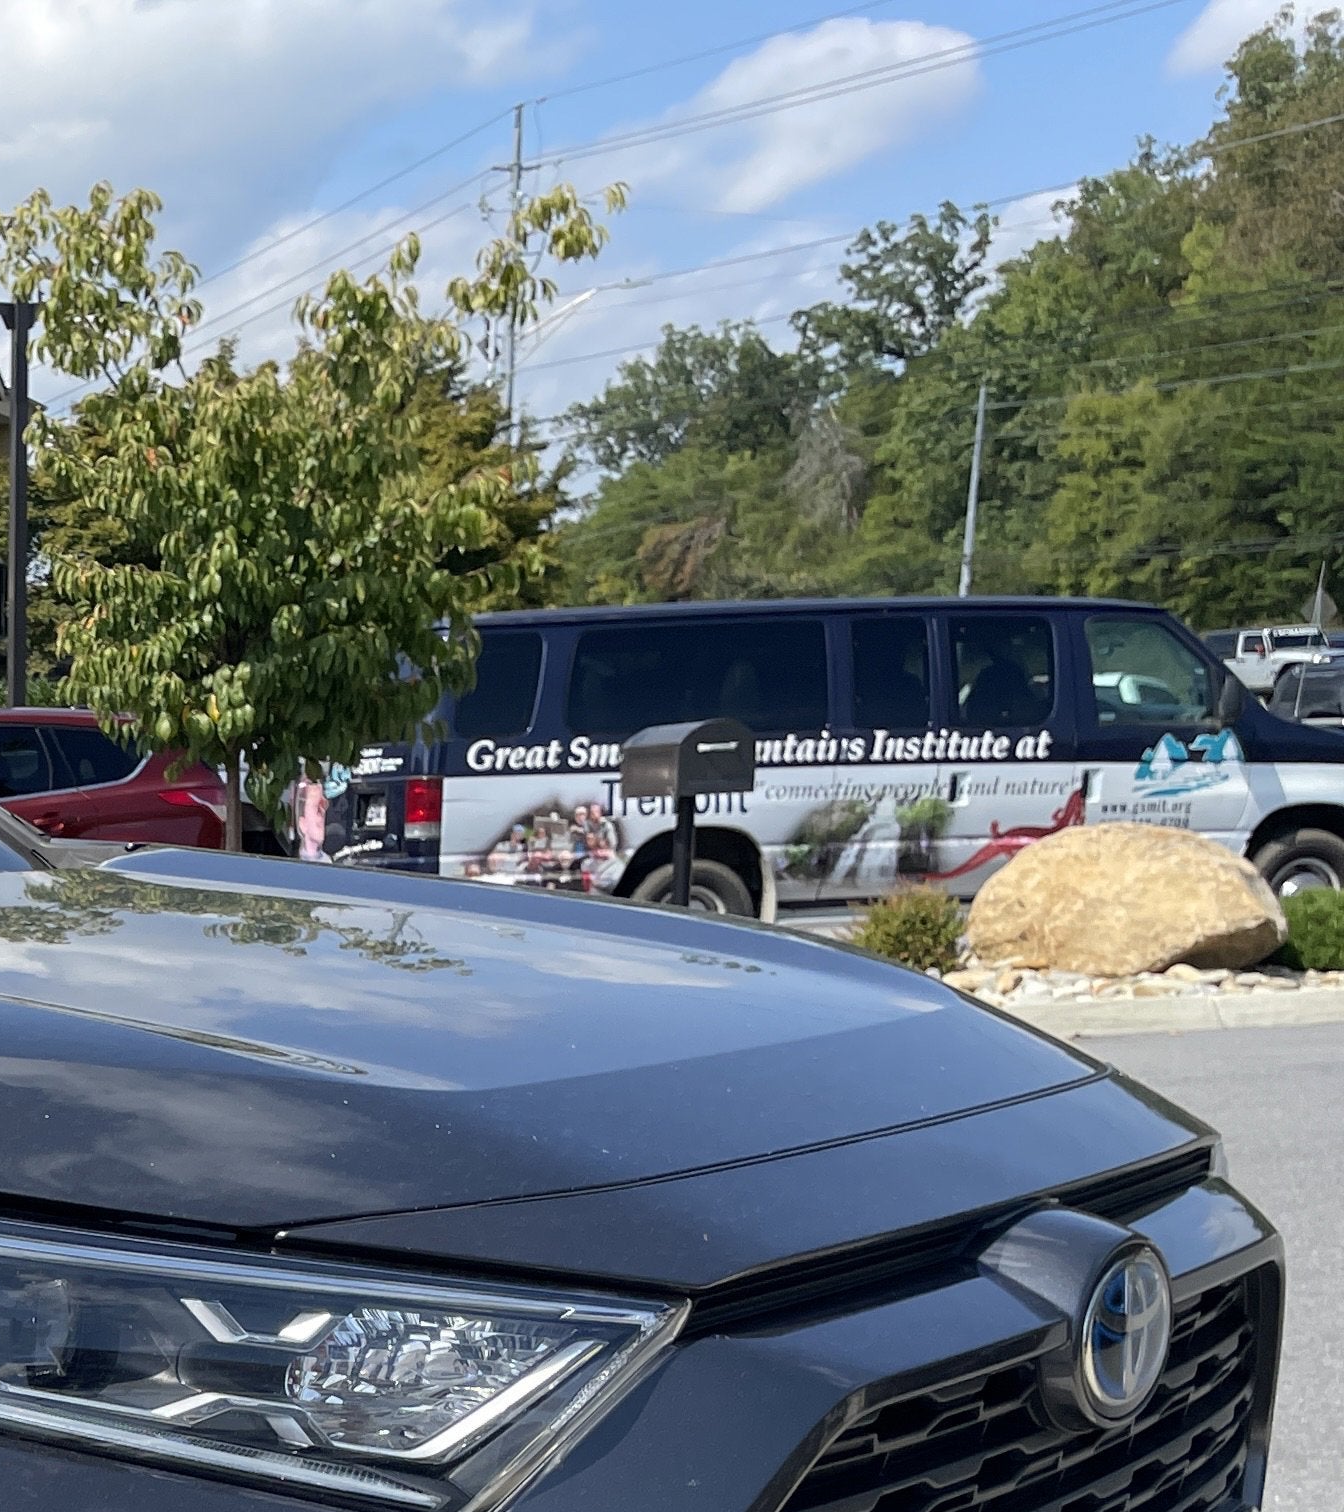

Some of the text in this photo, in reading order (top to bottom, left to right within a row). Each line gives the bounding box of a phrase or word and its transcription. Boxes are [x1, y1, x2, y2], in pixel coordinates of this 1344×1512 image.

[466, 738, 563, 772] Great
[869, 727, 1010, 763] Institute
[1014, 729, 1054, 761] at
